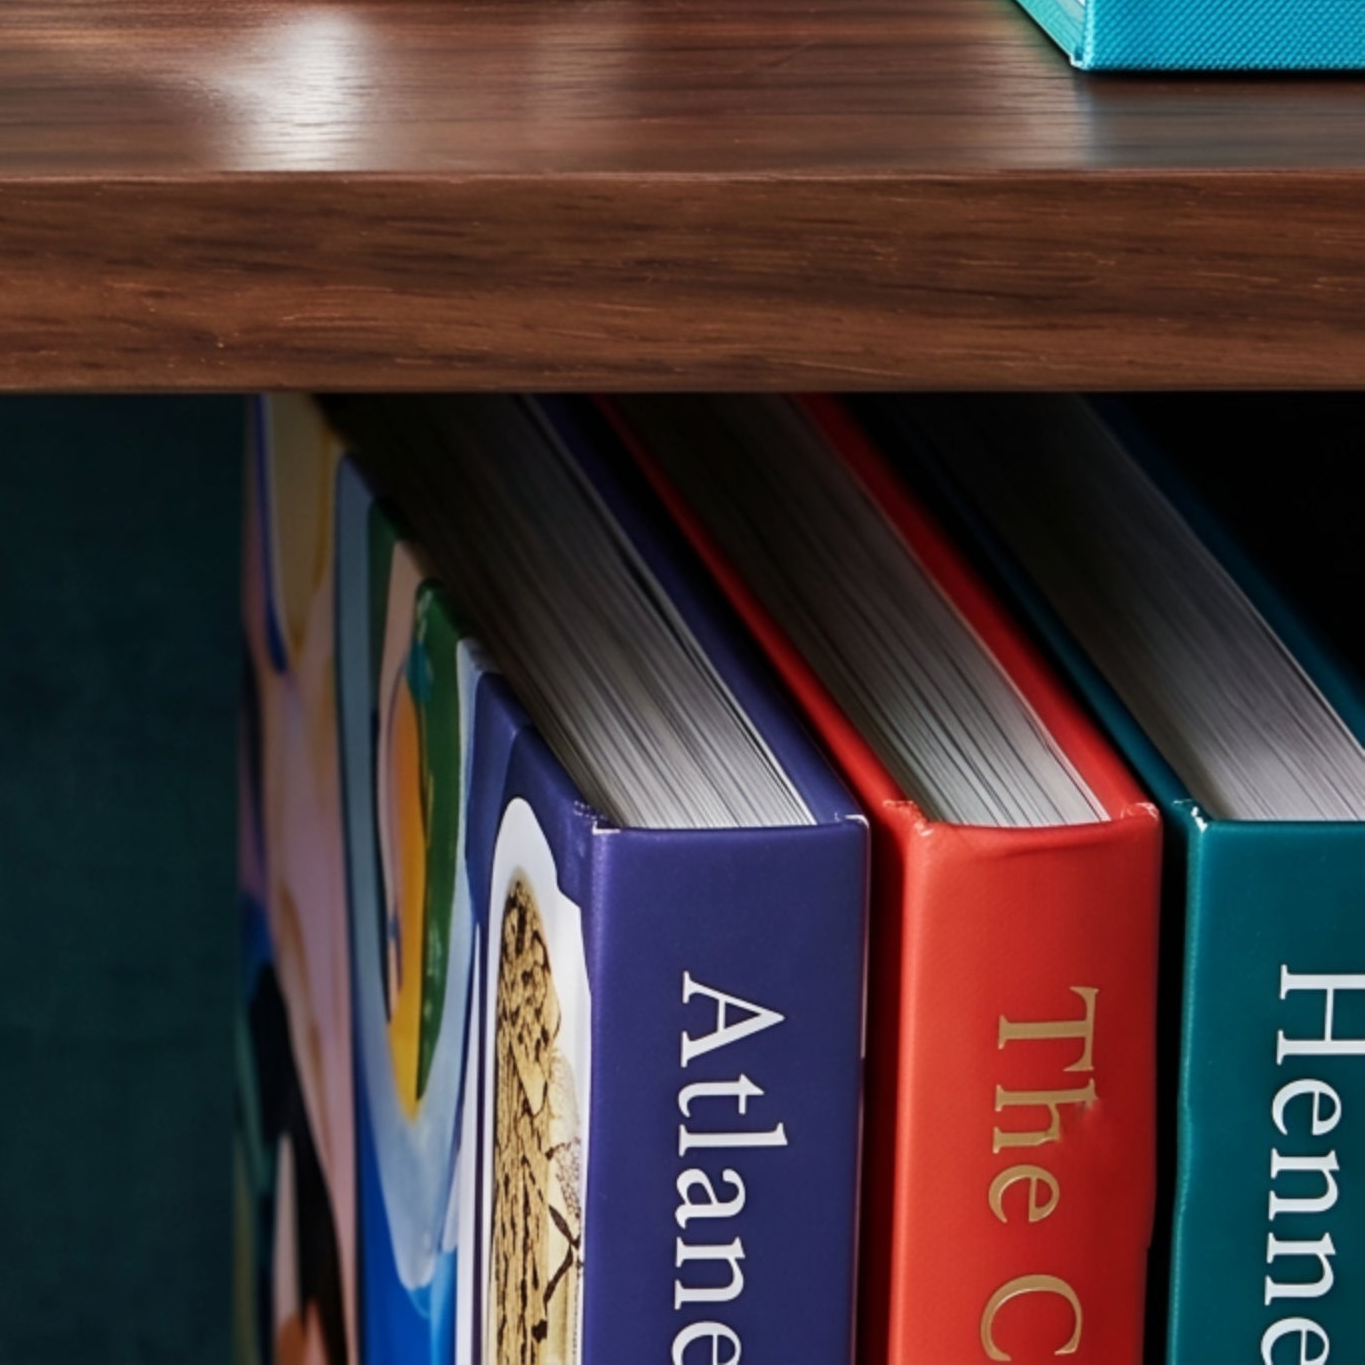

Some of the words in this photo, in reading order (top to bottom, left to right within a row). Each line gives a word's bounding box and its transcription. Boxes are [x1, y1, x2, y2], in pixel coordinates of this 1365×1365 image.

[671, 970, 788, 1365] Atlane
[989, 986, 1099, 1223] The
[1261, 964, 1365, 1365] Henne
[980, 1274, 1083, 1362] C
